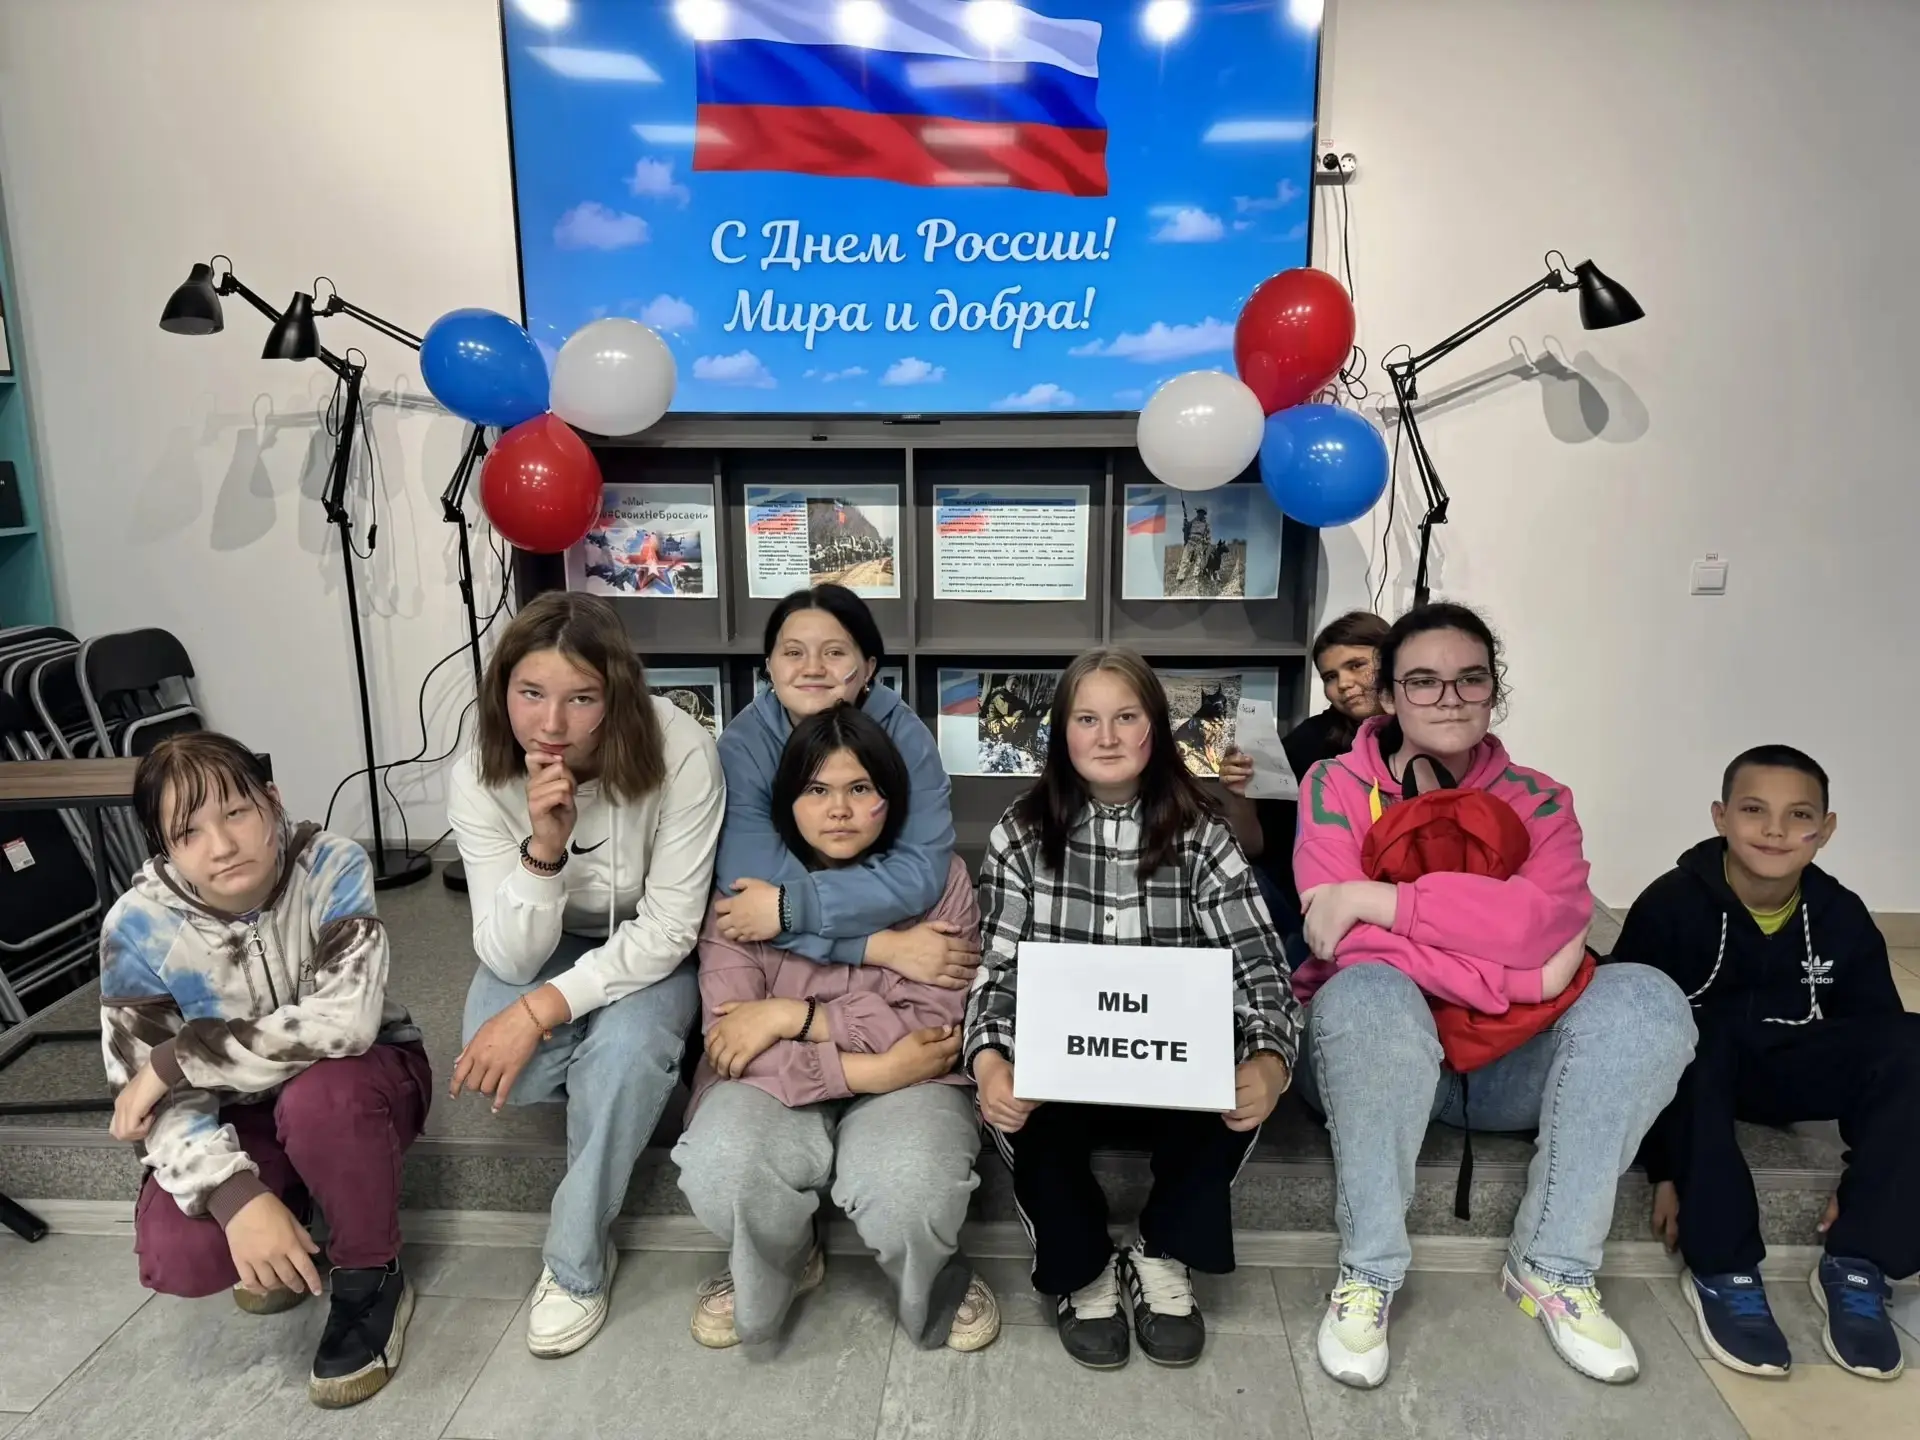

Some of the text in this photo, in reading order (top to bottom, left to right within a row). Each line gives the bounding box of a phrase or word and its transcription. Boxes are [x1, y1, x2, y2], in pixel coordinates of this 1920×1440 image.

[711, 216, 1117, 271] С Днем России!
[723, 284, 1096, 350] Мира и добра!
[1098, 991, 1148, 1014] МЫ
[1066, 1034, 1188, 1062] ВМЕСТЕ
